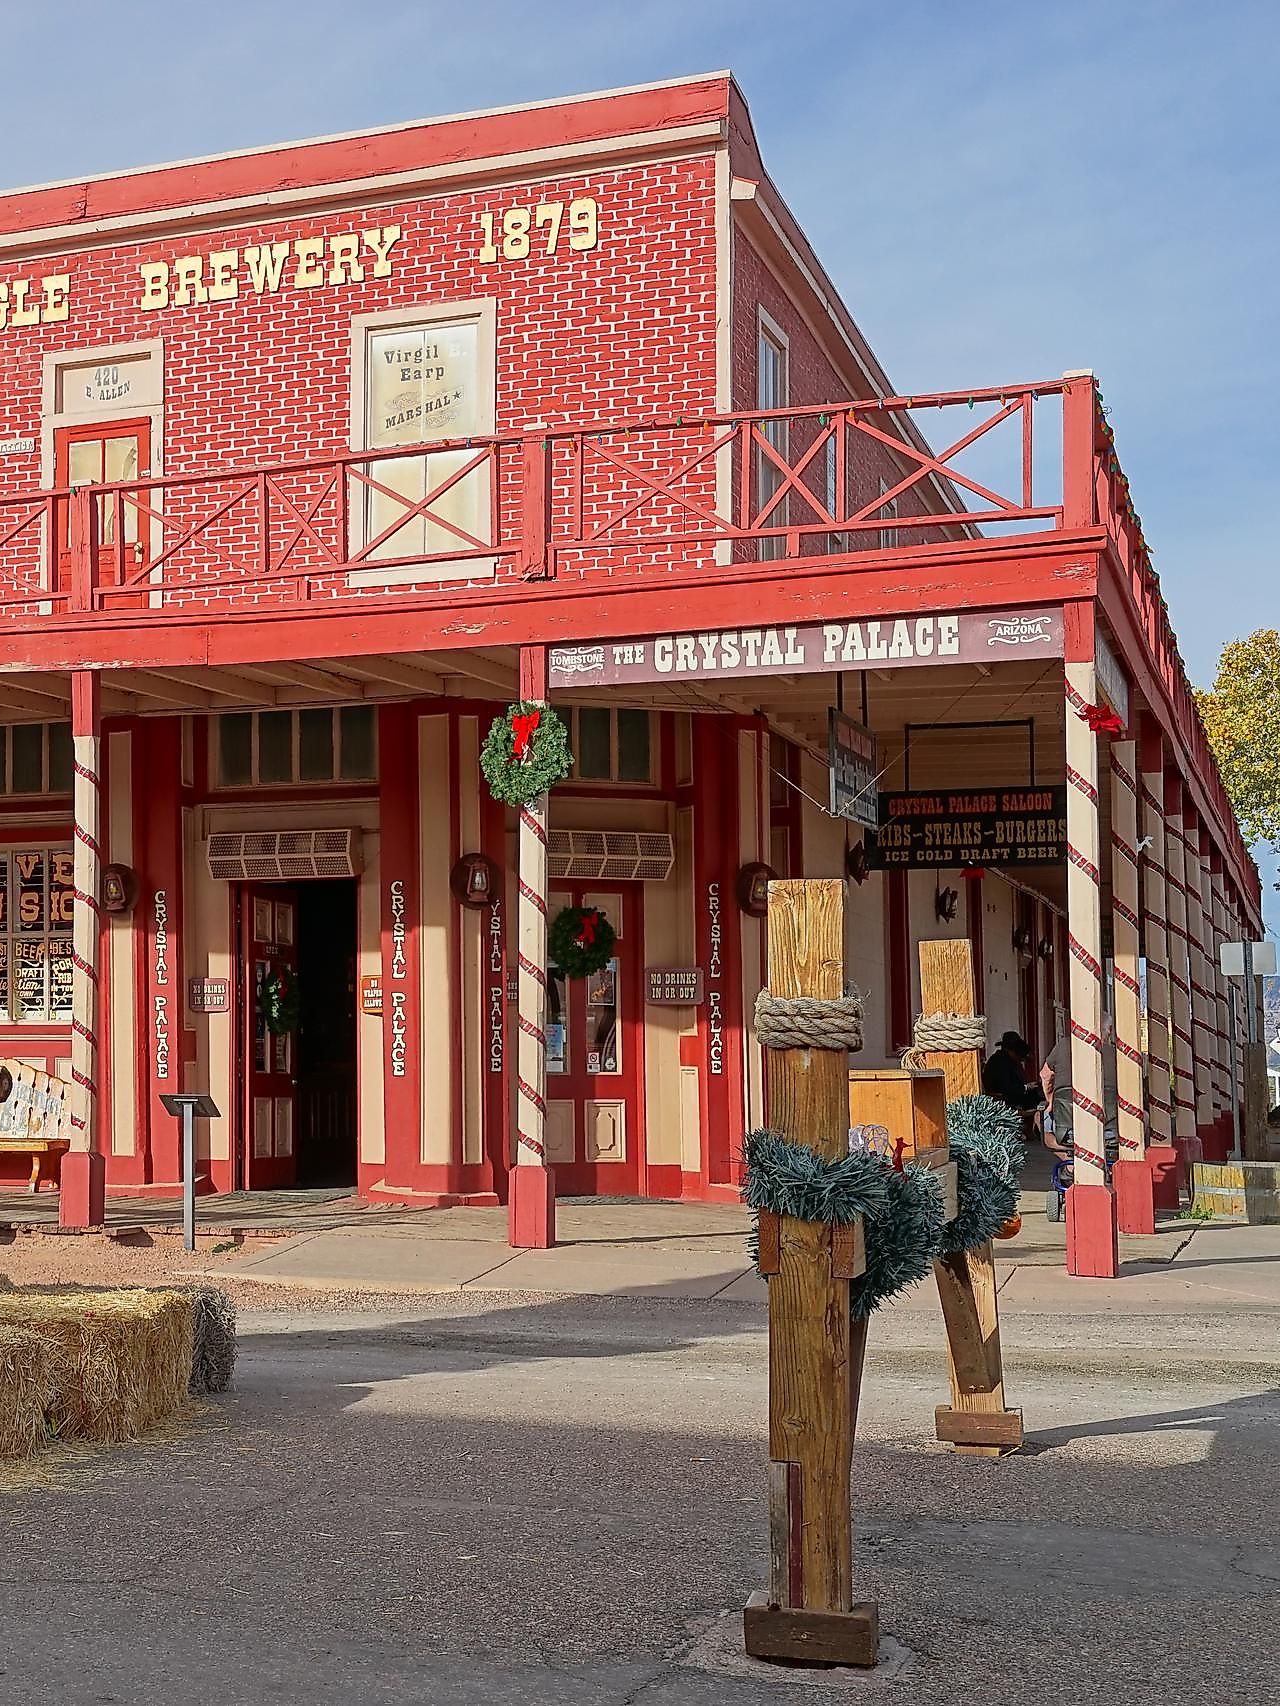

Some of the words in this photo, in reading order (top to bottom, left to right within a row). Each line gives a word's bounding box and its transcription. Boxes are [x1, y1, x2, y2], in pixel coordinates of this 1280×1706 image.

[139, 225, 402, 311] BREWERY
[477, 197, 598, 265] 1879
[383, 345, 439, 364] Virgil
[94, 366, 119, 387] 420
[400, 366, 445, 381] Earp
[99, 381, 131, 401] ALLEN
[385, 395, 451, 429] MARSHAL
[550, 653, 605, 666] TOMBSTONE
[612, 644, 645, 665] THE
[654, 627, 805, 674] CRYSTAL
[822, 615, 961, 664] PALACE
[995, 623, 1043, 637] ARIZONA
[888, 798, 944, 816] CRYSTAL
[948, 794, 998, 813] PALACE
[1002, 793, 1053, 812] SALOON
[885, 851, 910, 862] ICE
[916, 850, 953, 861] COLD
[960, 848, 1011, 861] DRAFT
[1016, 846, 1059, 859] BEER
[154, 890, 168, 985] CRYSTAL
[390, 880, 407, 979] CRYSTAL
[708, 883, 721, 979] CRYSTAL
[15, 942, 46, 963] BEER
[650, 973, 663, 985] NO
[665, 973, 697, 985] DRINKS
[651, 988, 662, 999] IN
[665, 988, 675, 999] OR
[679, 988, 695, 999] OUT
[154, 996, 168, 1078] PALACE
[391, 992, 407, 1077] PALACE
[490, 987, 502, 1073] PALACE
[709, 992, 722, 1074] PALACE
